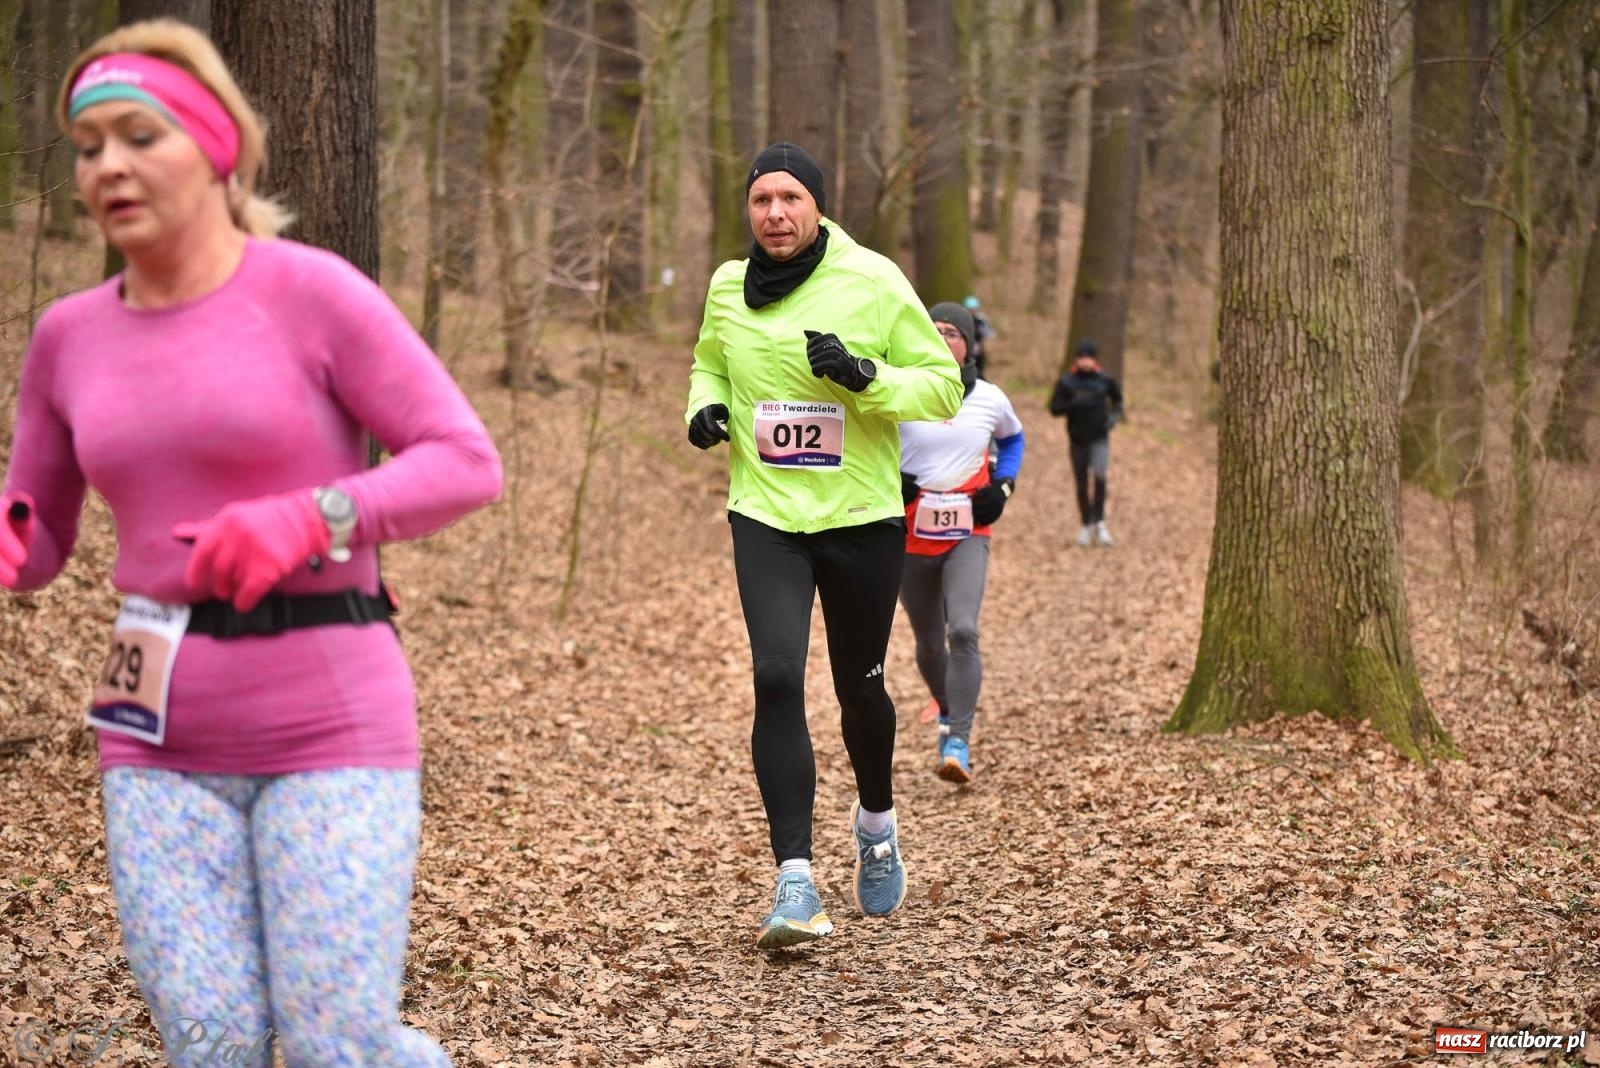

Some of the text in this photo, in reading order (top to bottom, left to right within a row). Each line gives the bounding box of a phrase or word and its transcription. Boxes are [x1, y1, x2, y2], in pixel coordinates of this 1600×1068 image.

[783, 405, 836, 413] Twardziela
[773, 423, 822, 449] 012
[933, 510, 958, 526] 131
